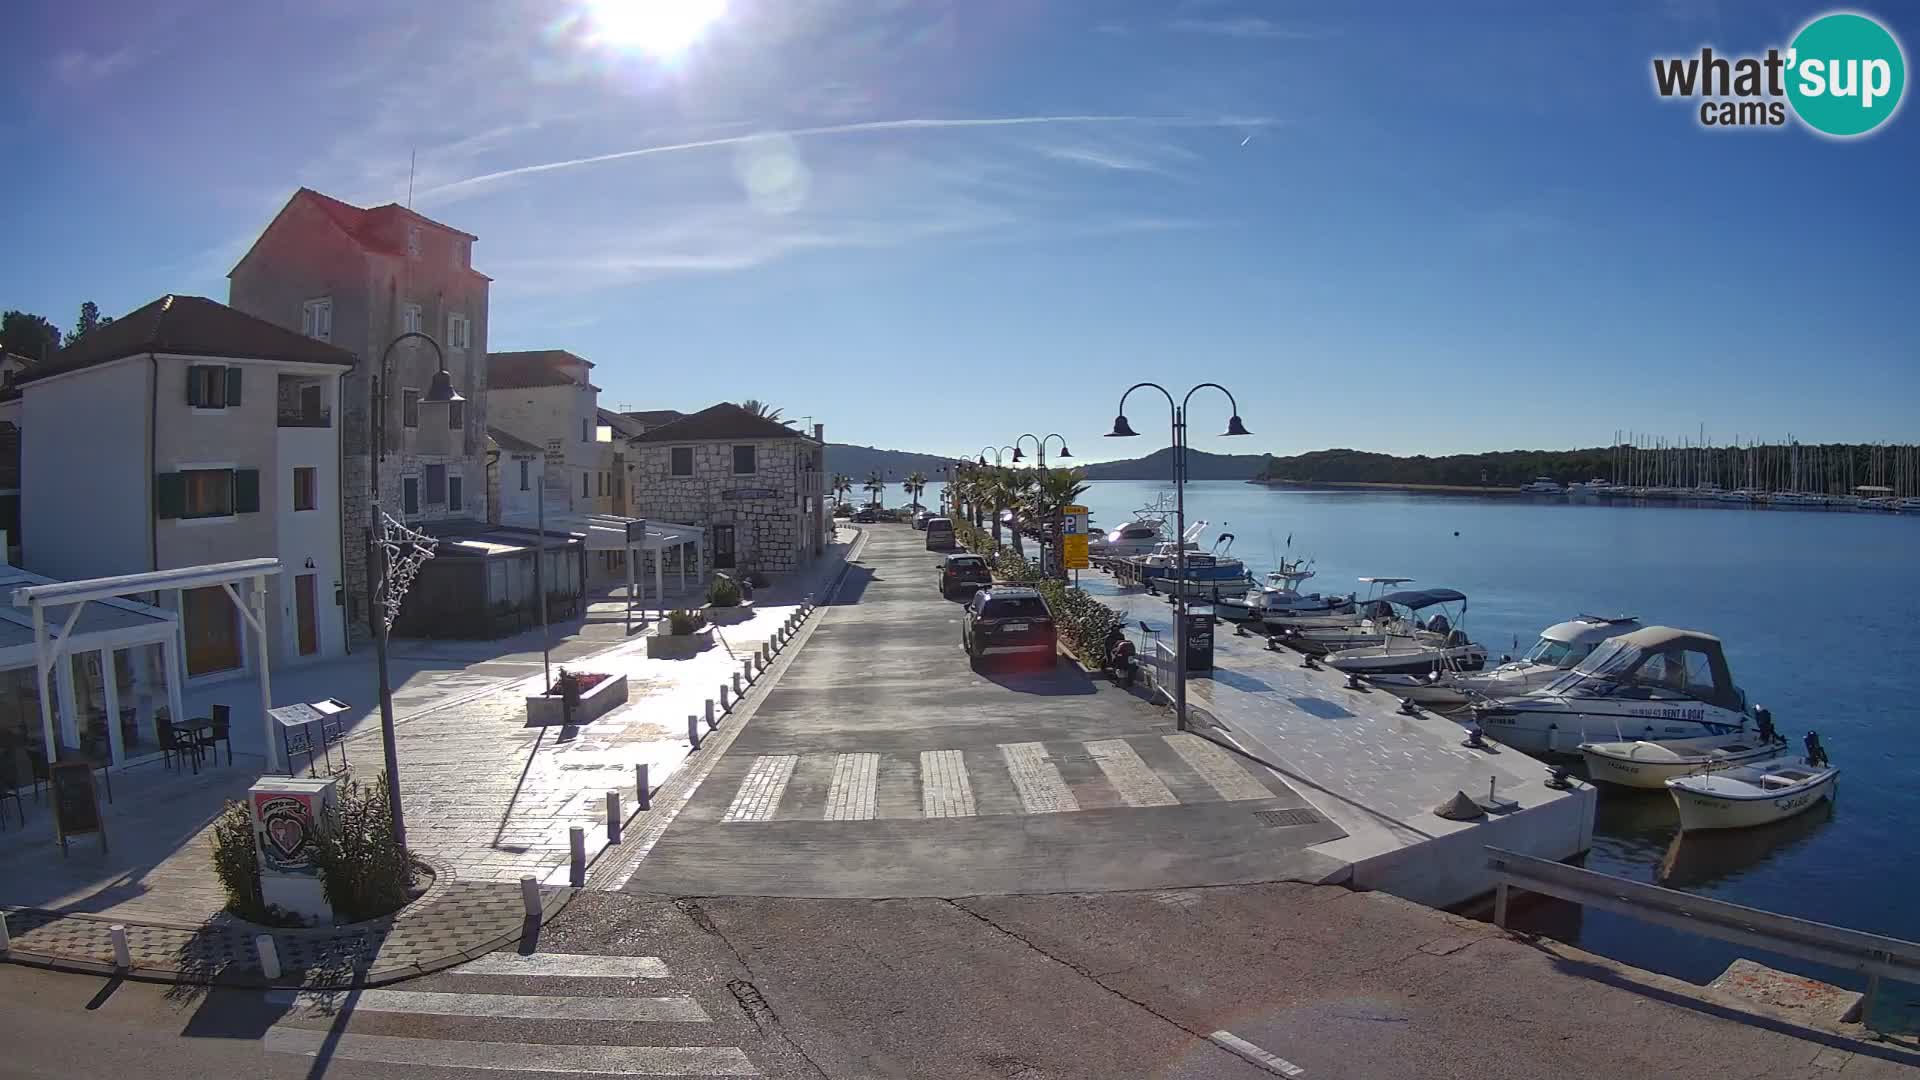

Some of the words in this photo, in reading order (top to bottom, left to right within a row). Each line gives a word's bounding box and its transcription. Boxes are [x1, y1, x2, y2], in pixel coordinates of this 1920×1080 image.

[1065, 516, 1076, 533] P
[1663, 709, 1681, 718] RENT
[1688, 709, 1704, 720] BOAT
